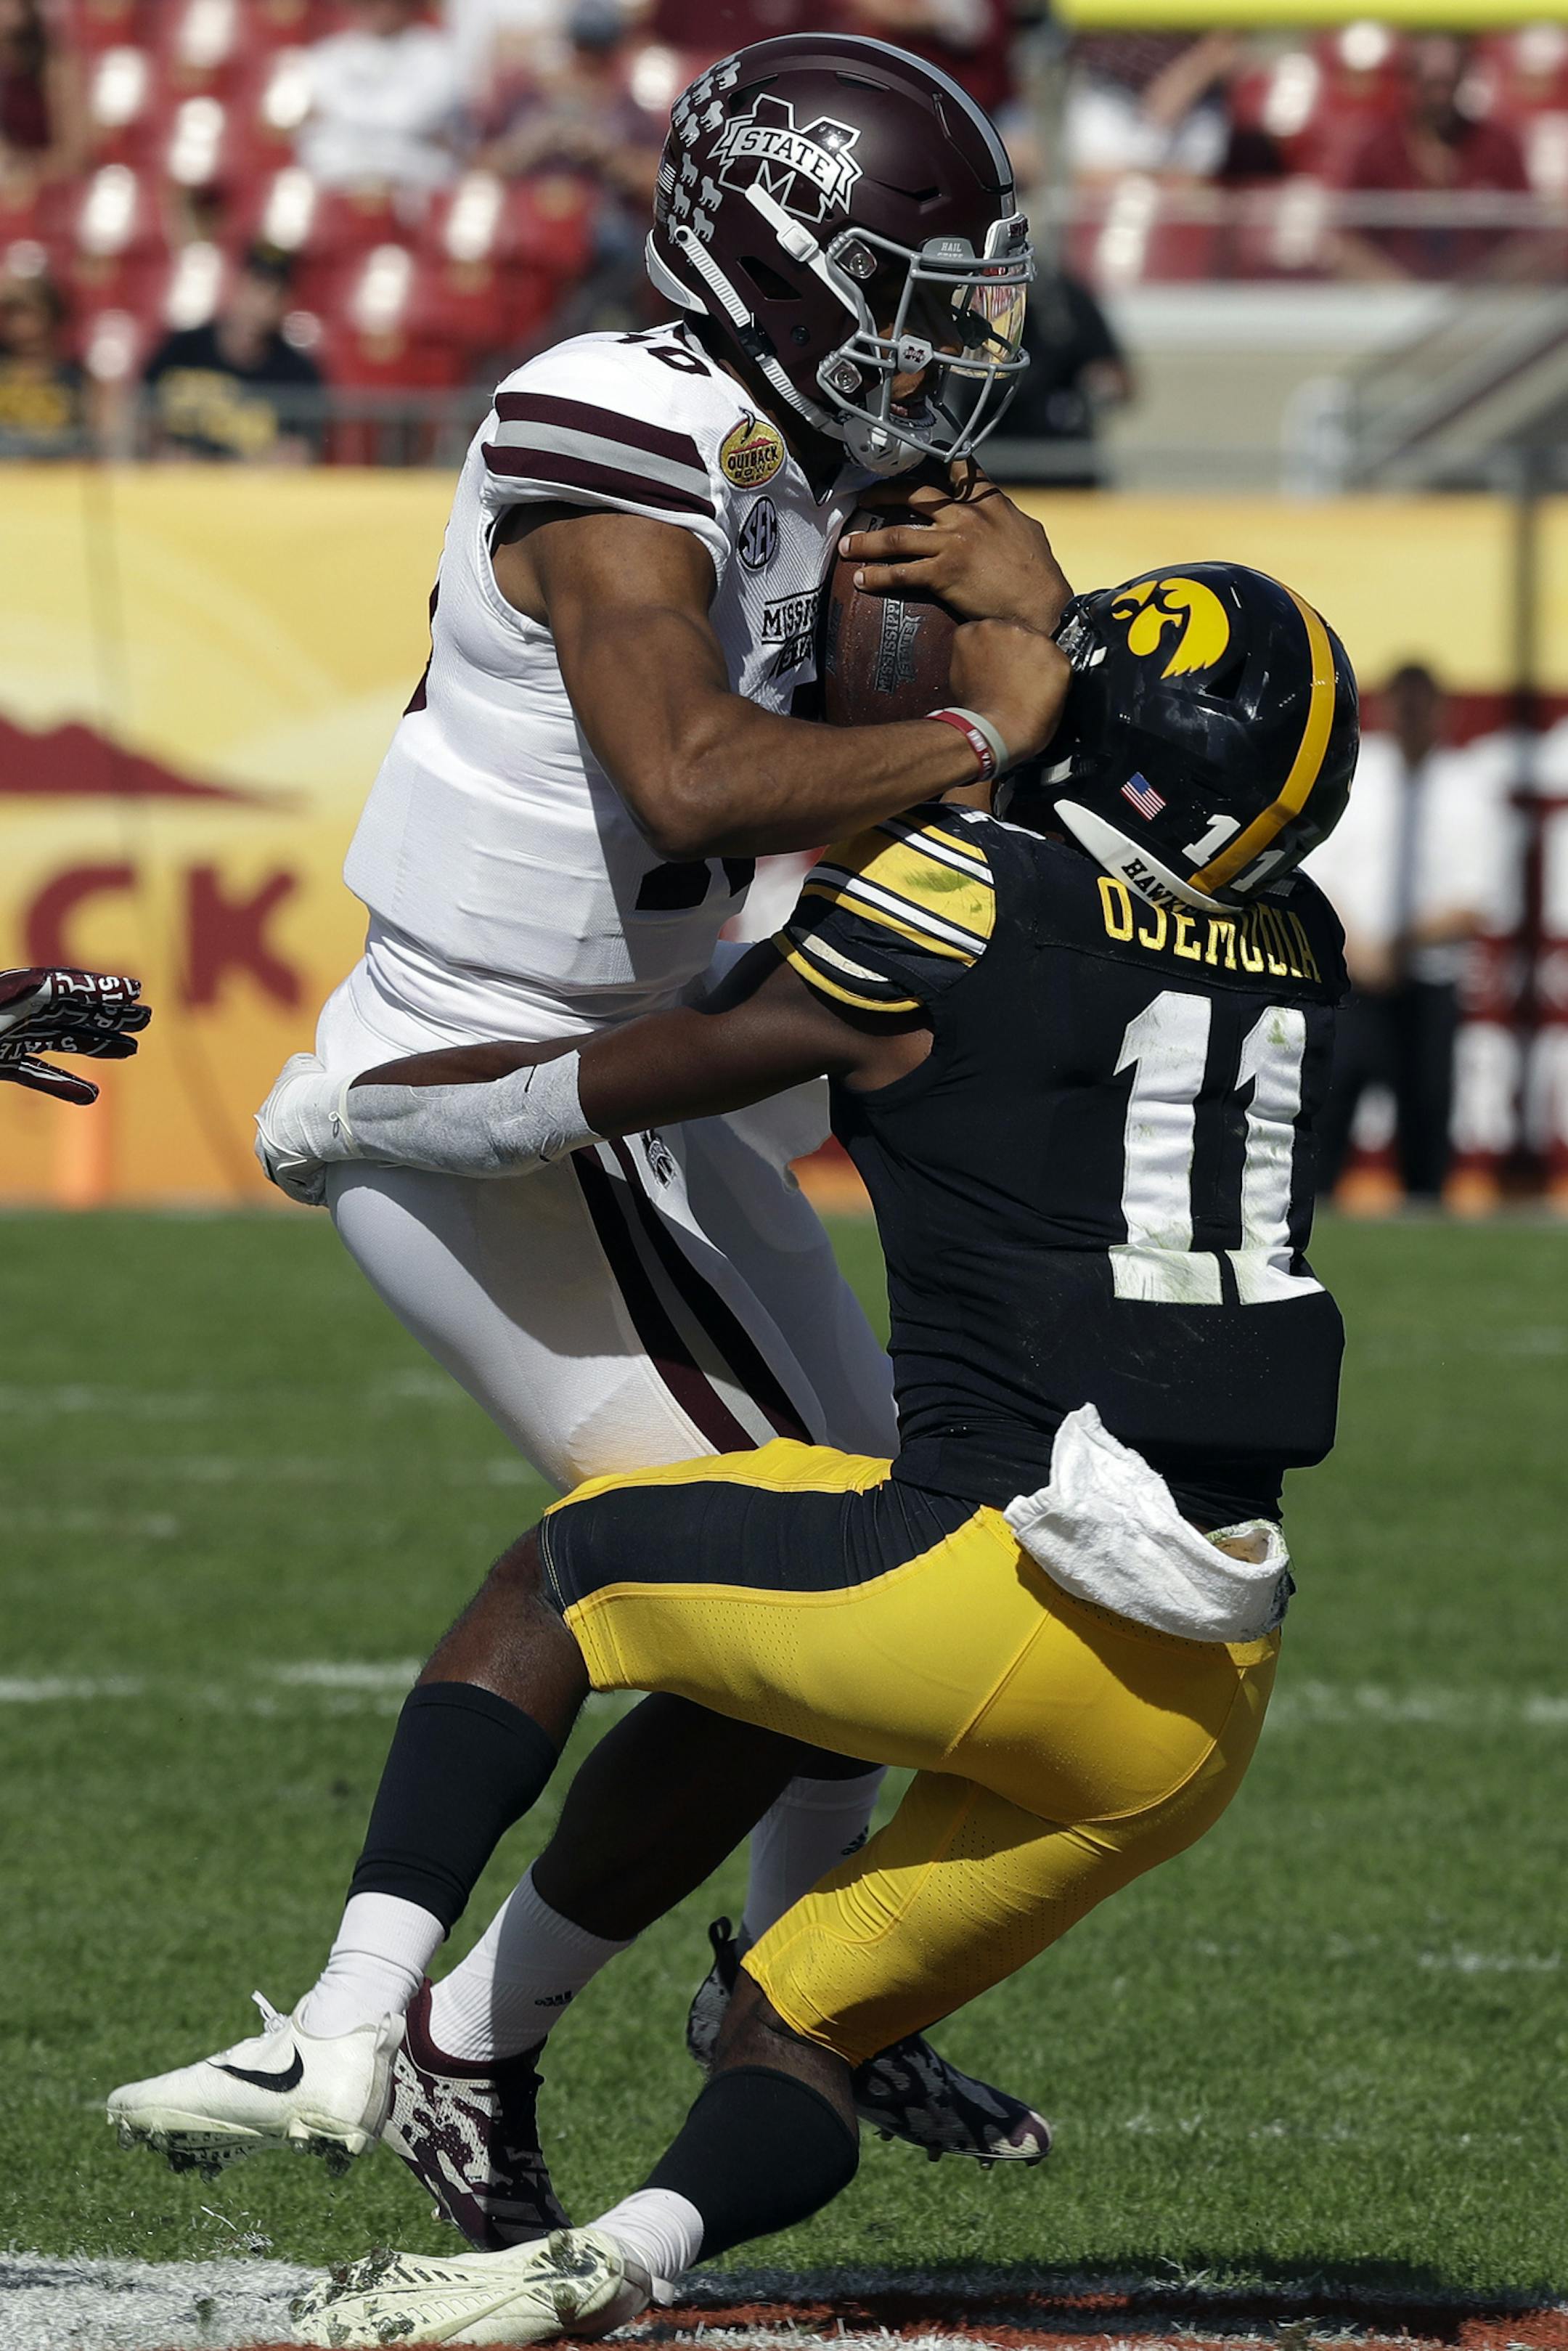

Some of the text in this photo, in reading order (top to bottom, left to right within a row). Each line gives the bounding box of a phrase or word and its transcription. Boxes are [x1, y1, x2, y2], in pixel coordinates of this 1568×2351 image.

[740, 131, 831, 183] STATE
[941, 242, 962, 252] HAIL
[727, 446, 778, 470] OUTBACK
[735, 463, 774, 478] BOWL
[741, 500, 776, 565] SEC
[877, 598, 901, 693] MISSISSIPPI
[899, 623, 915, 672] STATE
[1108, 990, 1326, 1305] 11
